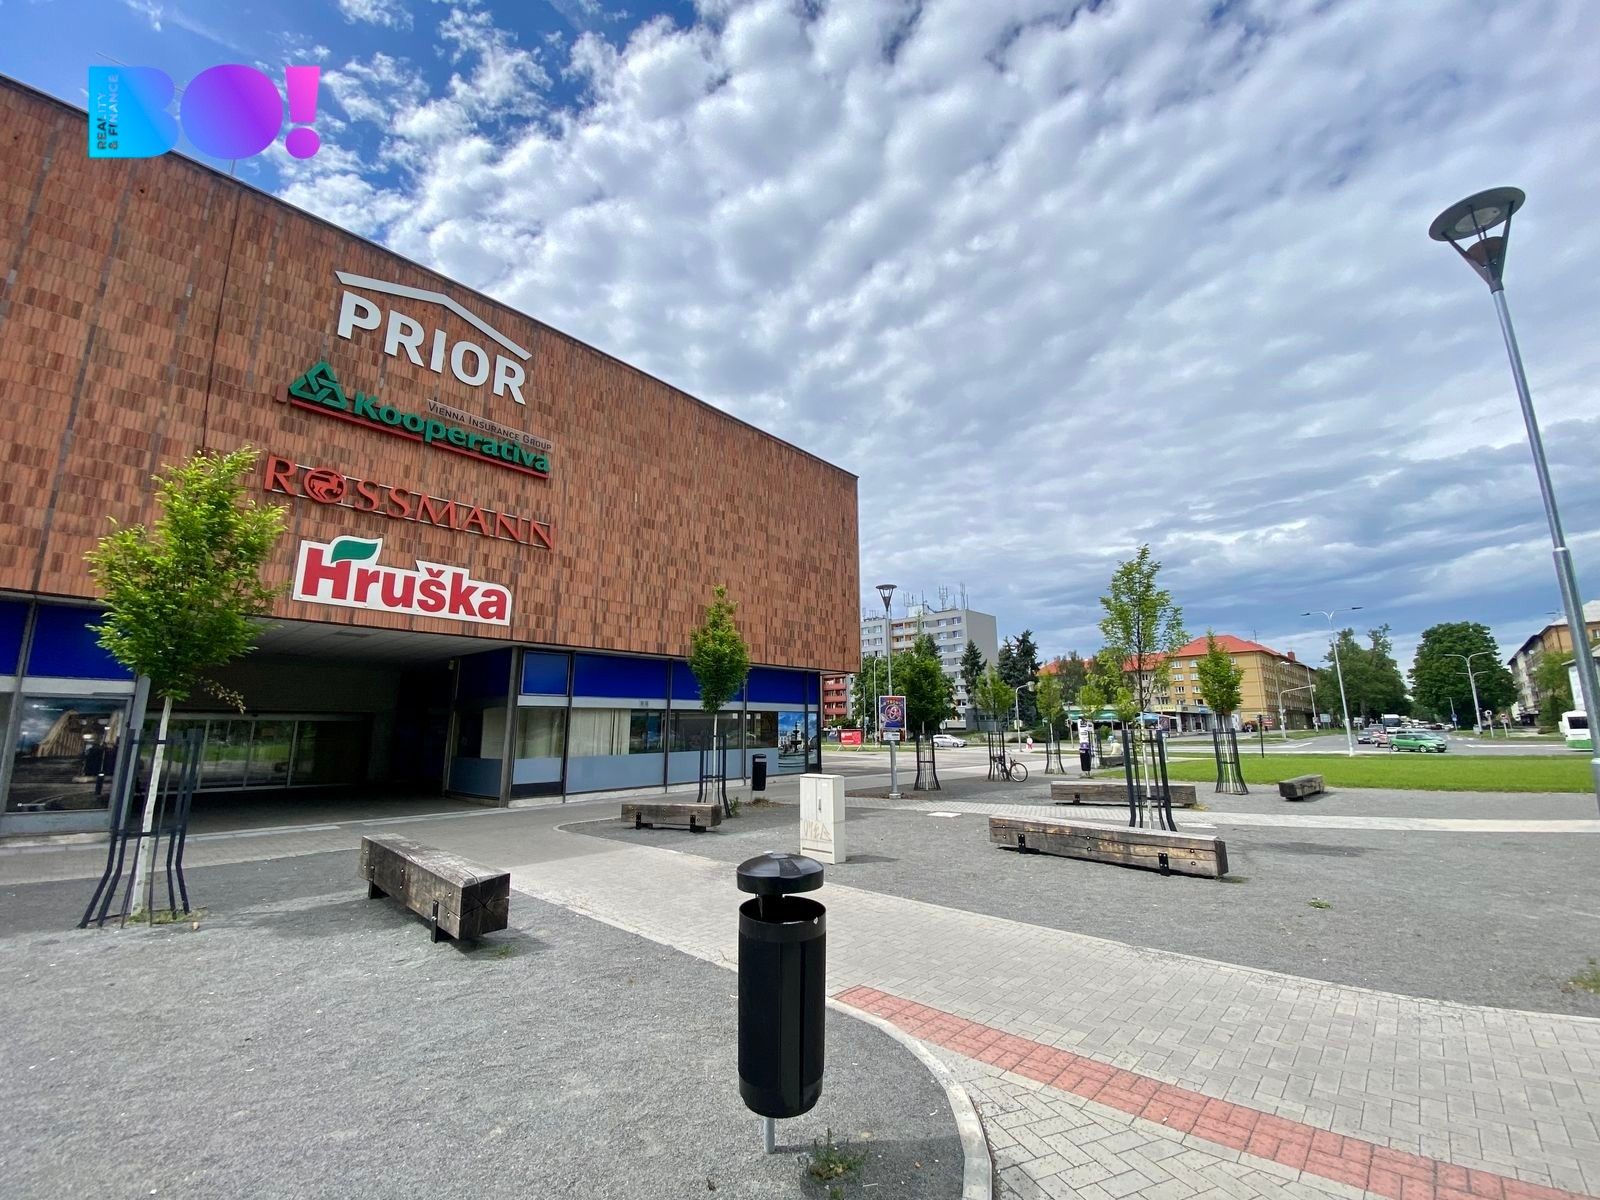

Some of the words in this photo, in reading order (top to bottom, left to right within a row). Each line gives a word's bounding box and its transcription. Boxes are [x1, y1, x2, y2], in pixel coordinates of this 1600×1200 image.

[337, 290, 526, 405] PRIOR
[353, 391, 551, 473] Kooperativa
[428, 401, 465, 423] VIENNA
[468, 416, 520, 441] INSURANCE
[522, 435, 552, 451] GROUP
[264, 454, 553, 549] ROSSMANN
[300, 545, 507, 621] Hruška
